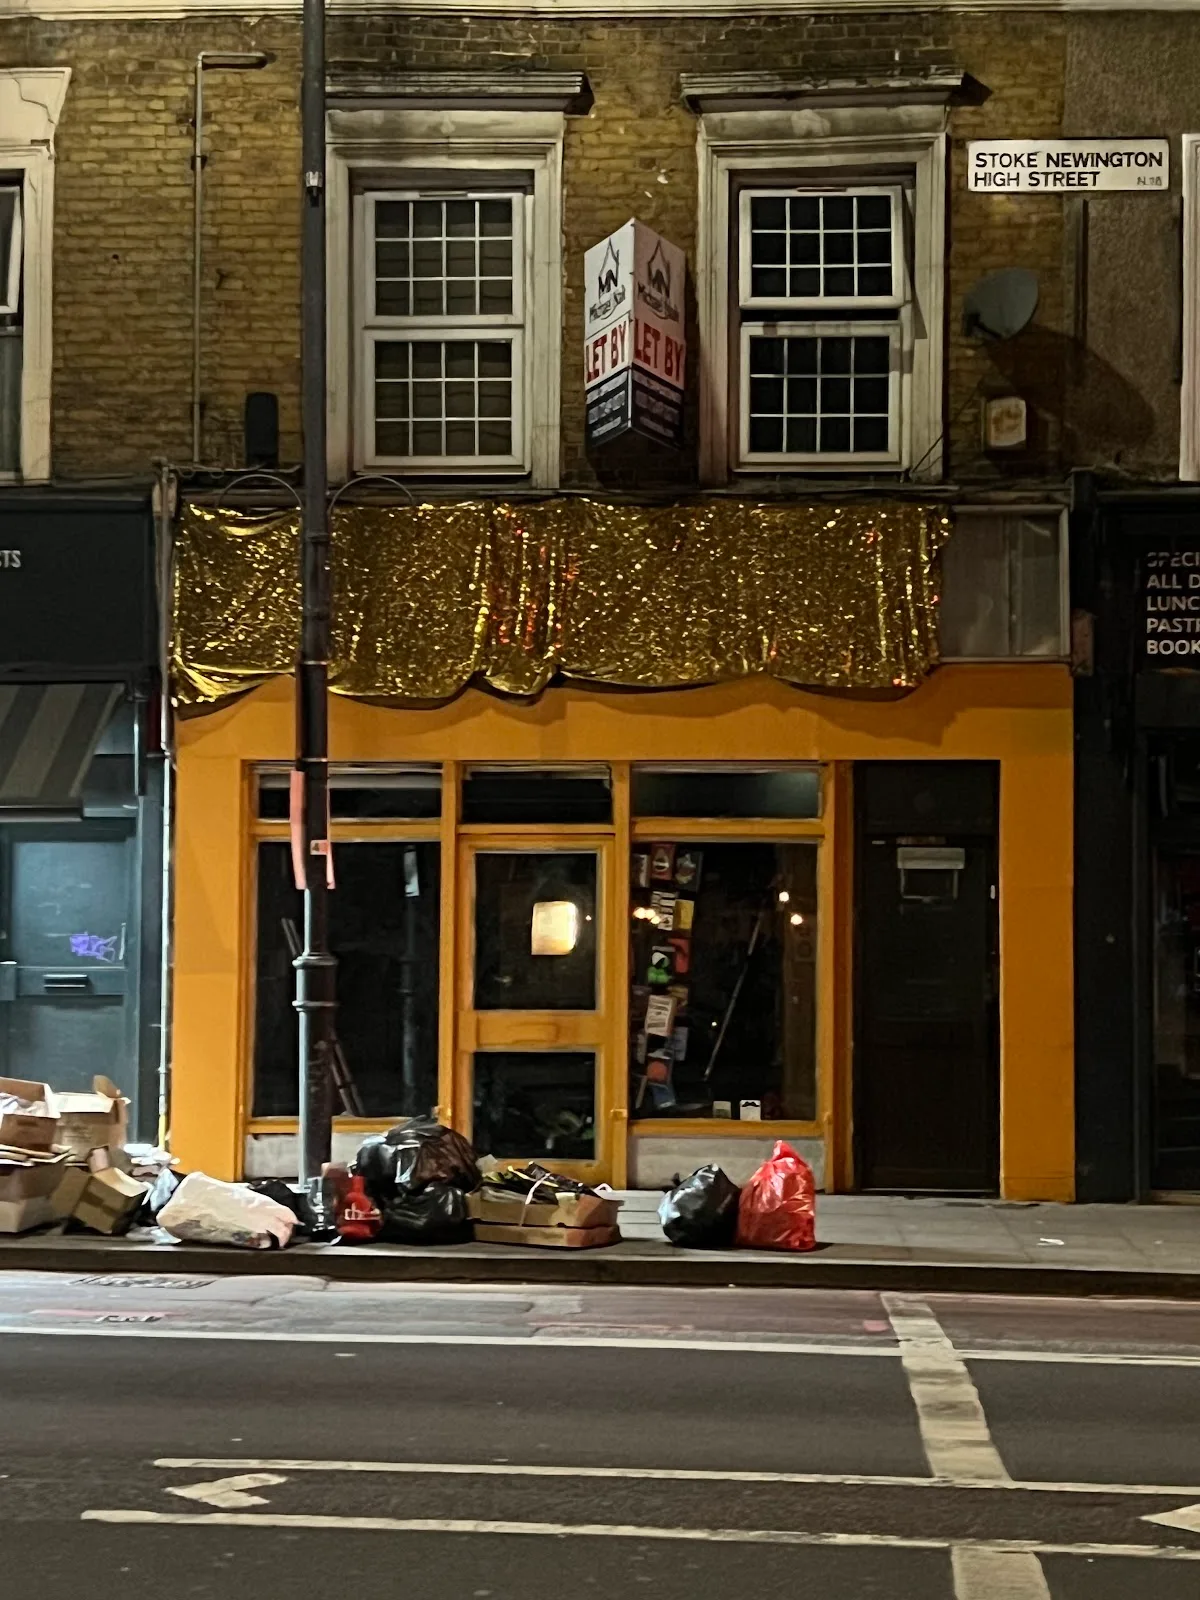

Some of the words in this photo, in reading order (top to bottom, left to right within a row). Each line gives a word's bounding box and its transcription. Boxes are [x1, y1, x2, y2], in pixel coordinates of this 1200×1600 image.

[975, 152, 1038, 168] STOKE
[1046, 151, 1163, 168] NEWINGTON
[974, 172, 1020, 187] HIGH
[1028, 171, 1101, 187] STREET
[585, 334, 608, 384] LET
[610, 320, 627, 369] BY
[634, 318, 661, 369] LET
[664, 335, 684, 382] BY
[0, 550, 21, 568] TS
[1146, 573, 1182, 589] ALL
